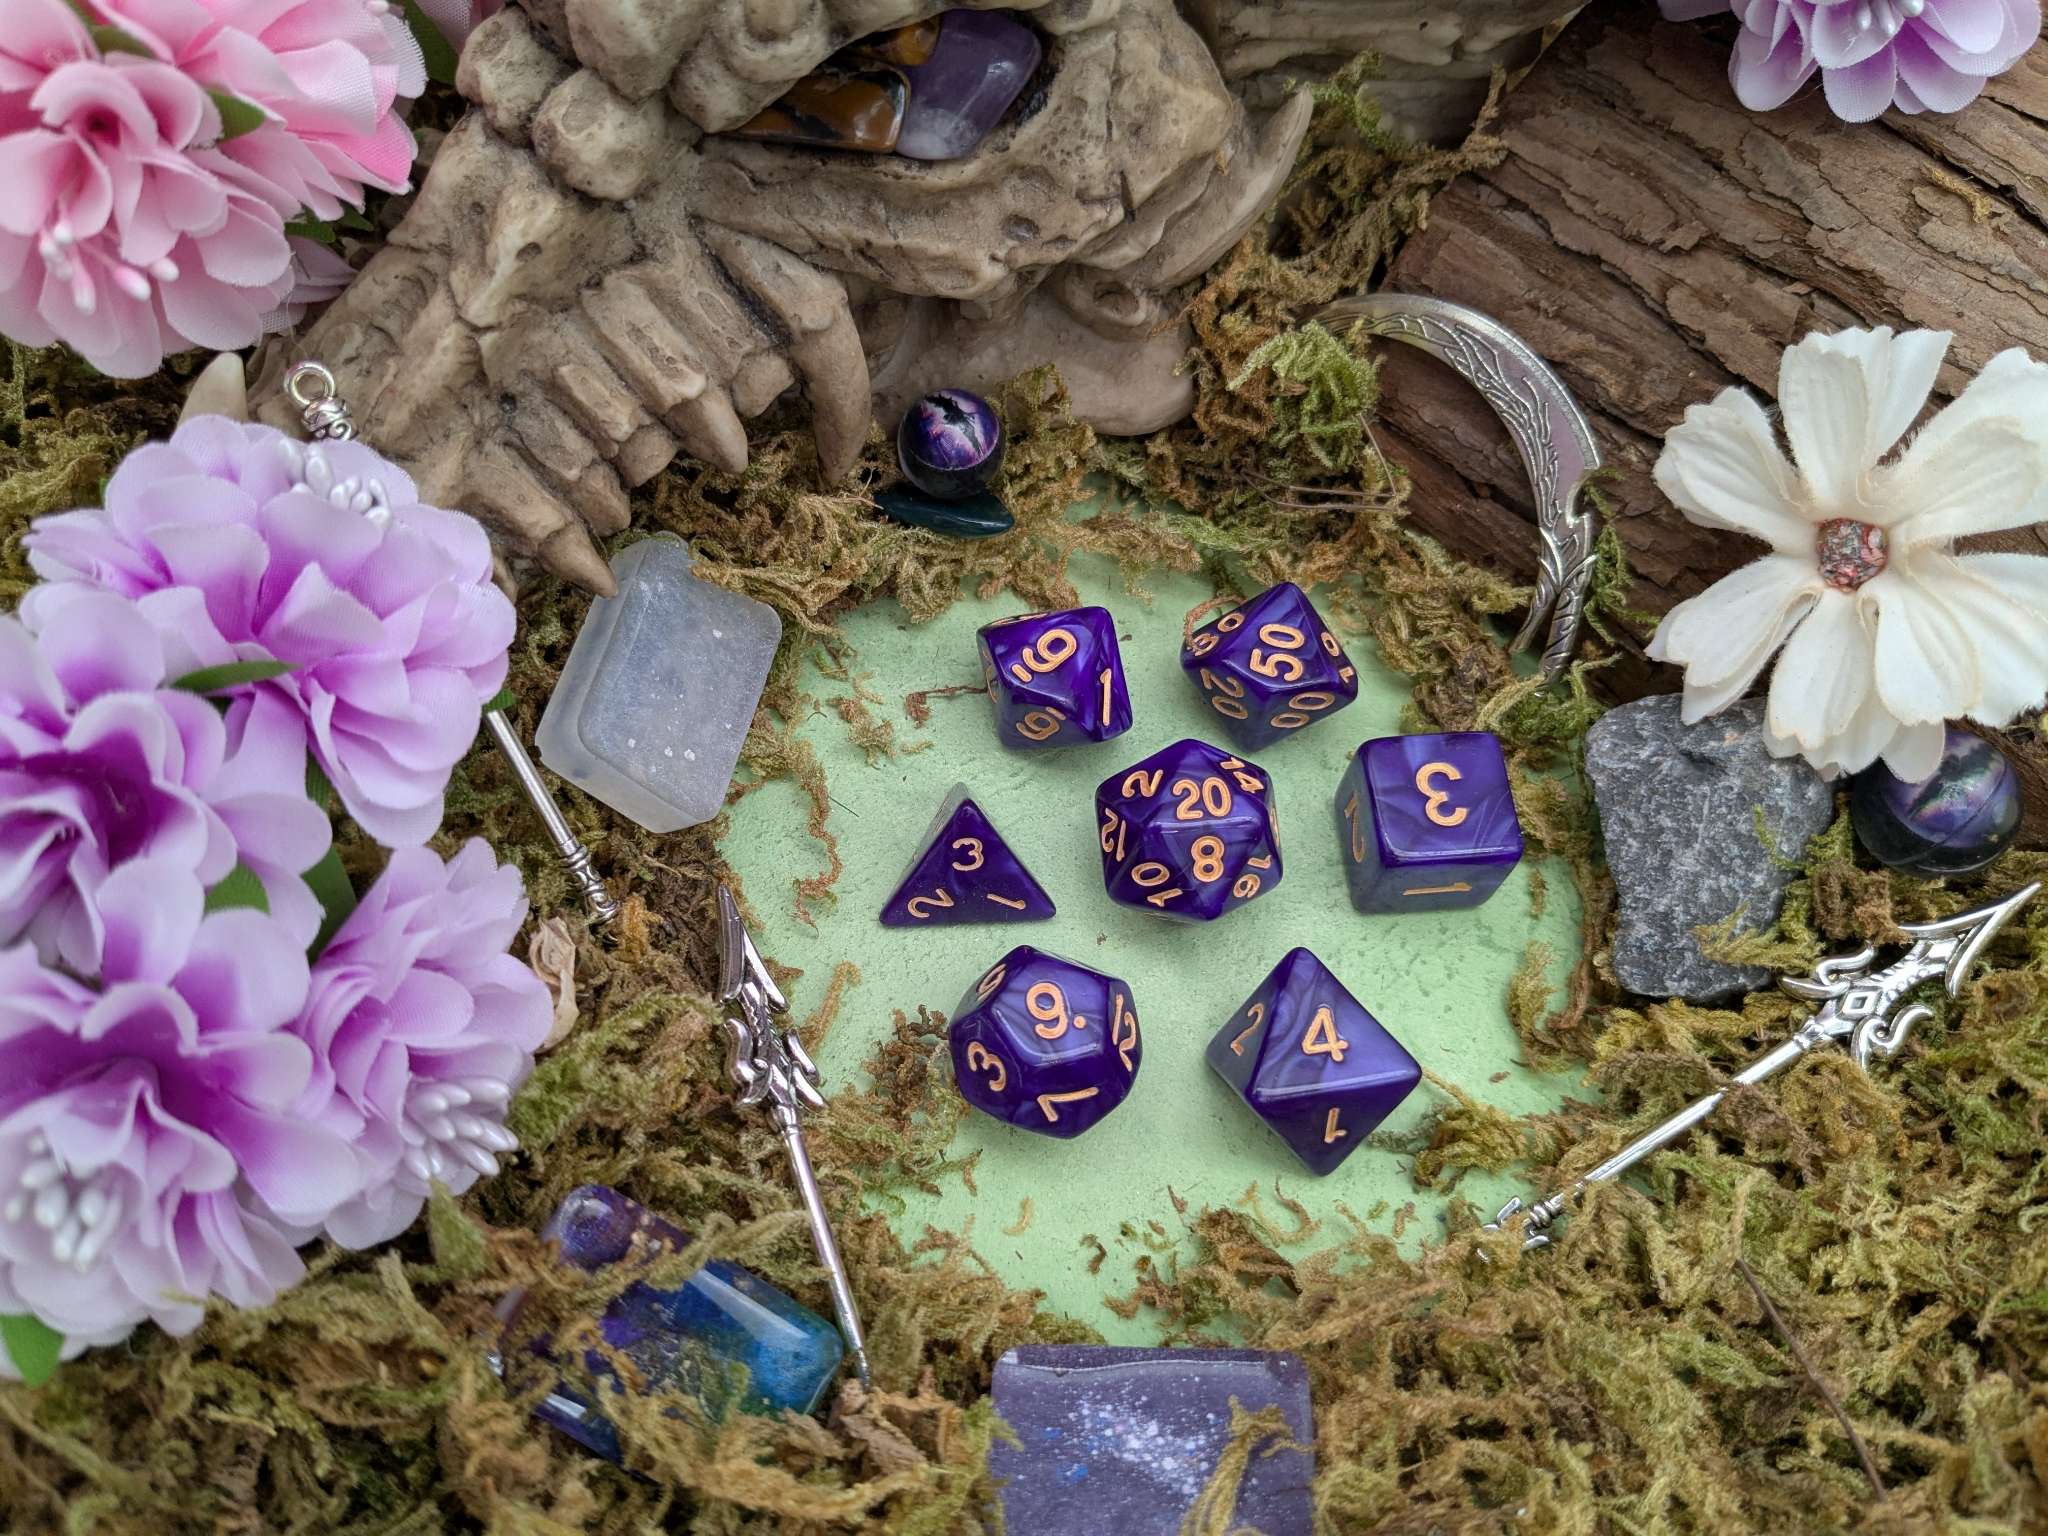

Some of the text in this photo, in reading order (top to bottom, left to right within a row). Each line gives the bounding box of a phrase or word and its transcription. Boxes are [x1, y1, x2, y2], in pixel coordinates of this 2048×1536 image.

[1249, 623, 1305, 682] 50
[1099, 667, 1112, 727] 1
[1200, 668, 1249, 720] 20
[1270, 691, 1336, 729] 00
[1121, 769, 1164, 799] 2
[1172, 776, 1232, 821] 20
[1219, 756, 1265, 794] 14
[1415, 761, 1470, 828] 3
[951, 837, 985, 872] 3
[1101, 807, 1127, 863] 12
[1190, 835, 1226, 883] 8
[907, 887, 955, 919] 2
[986, 893, 1027, 911] 1
[1130, 861, 1184, 908] 10
[1402, 881, 1473, 897] 1
[1111, 993, 1137, 1073] 12
[1230, 1002, 1265, 1057] 2
[1301, 1006, 1350, 1063] 4
[966, 1040, 1008, 1092] 3
[1324, 1107, 1348, 1144] 1
